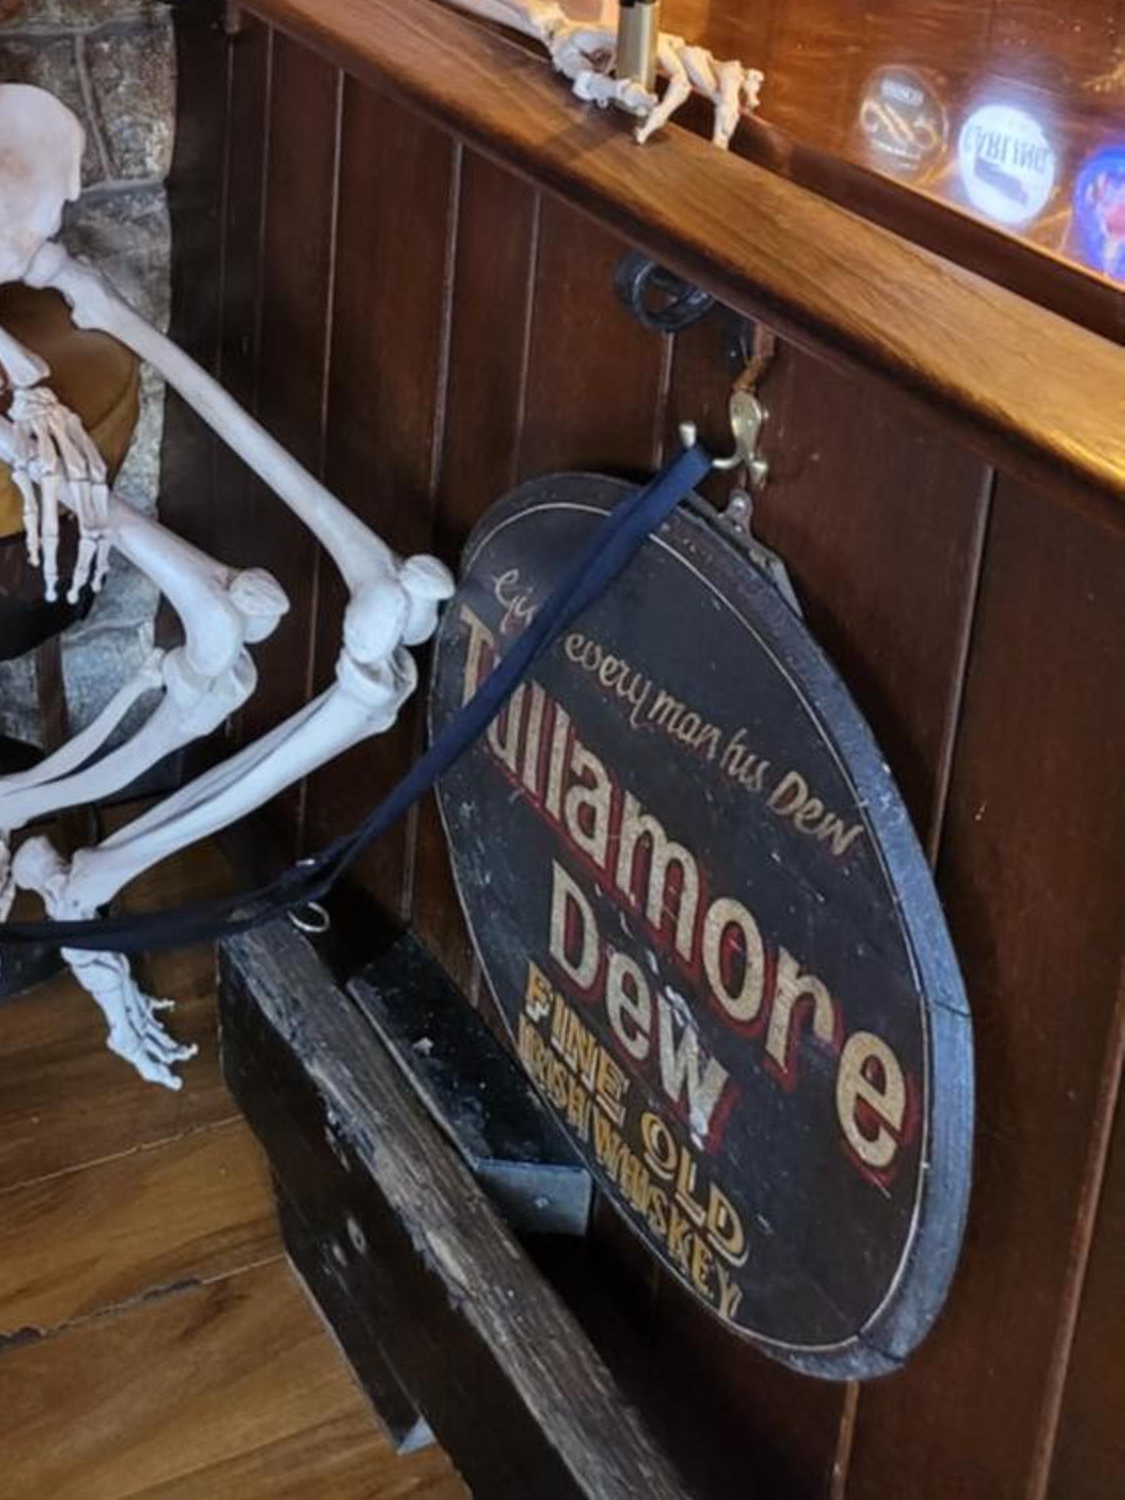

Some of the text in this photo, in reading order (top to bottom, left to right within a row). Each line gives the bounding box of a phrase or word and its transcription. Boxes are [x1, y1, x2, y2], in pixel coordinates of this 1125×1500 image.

[647, 689, 721, 761] man
[460, 604, 909, 1170] Tullamore
[550, 858, 731, 1151] Dew
[640, 1111, 749, 1268] OLD
